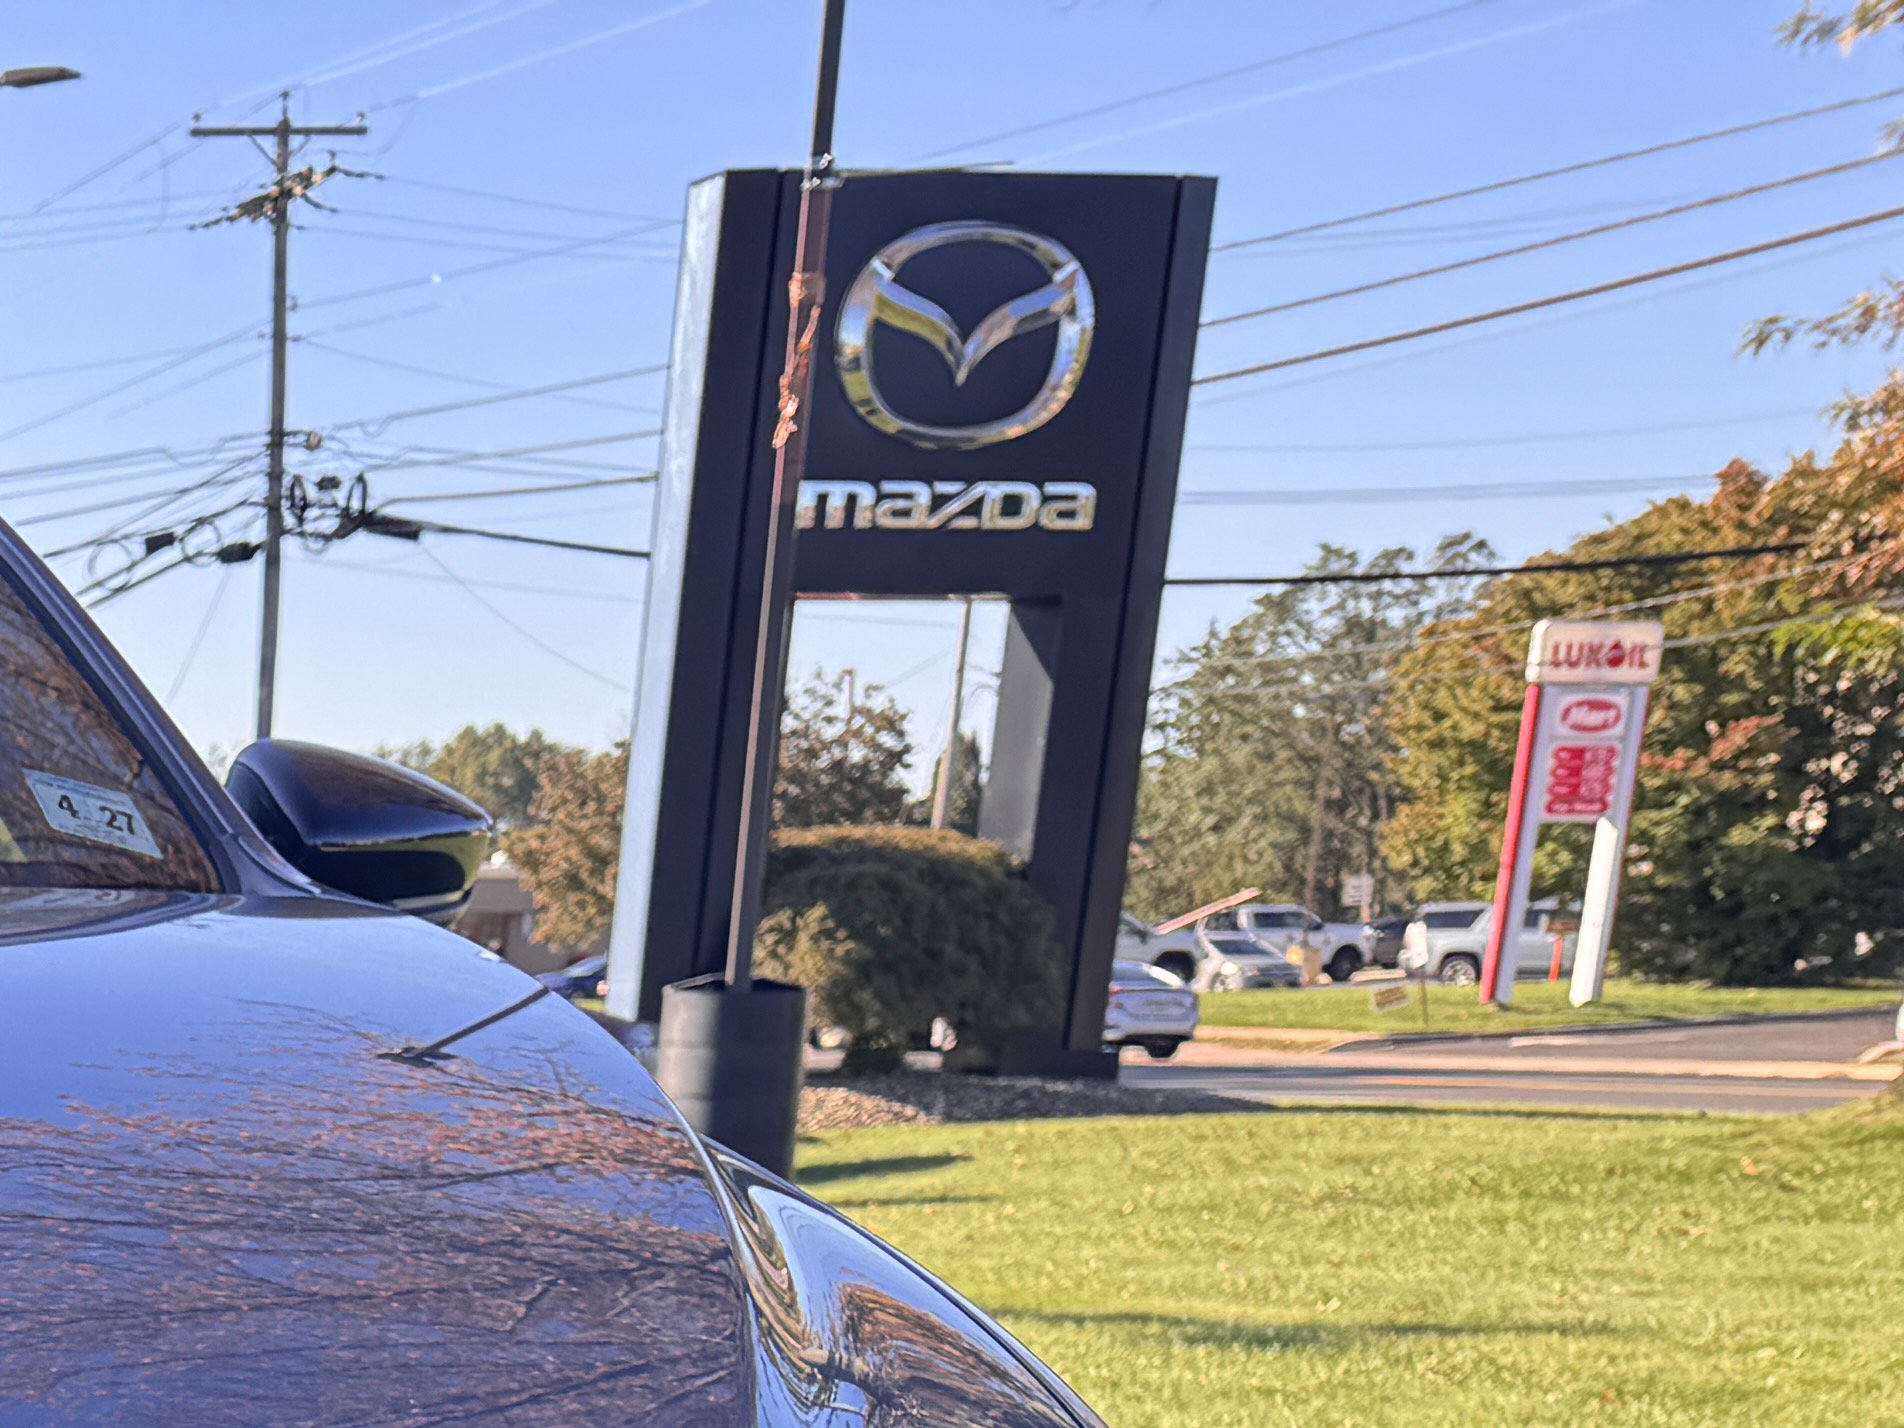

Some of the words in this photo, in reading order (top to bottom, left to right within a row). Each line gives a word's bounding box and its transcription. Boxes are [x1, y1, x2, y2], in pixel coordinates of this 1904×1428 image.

[793, 478, 1098, 531] mazda
[1549, 639, 1650, 669] LUKOIL
[58, 794, 81, 820] 4
[98, 804, 135, 836] 27
